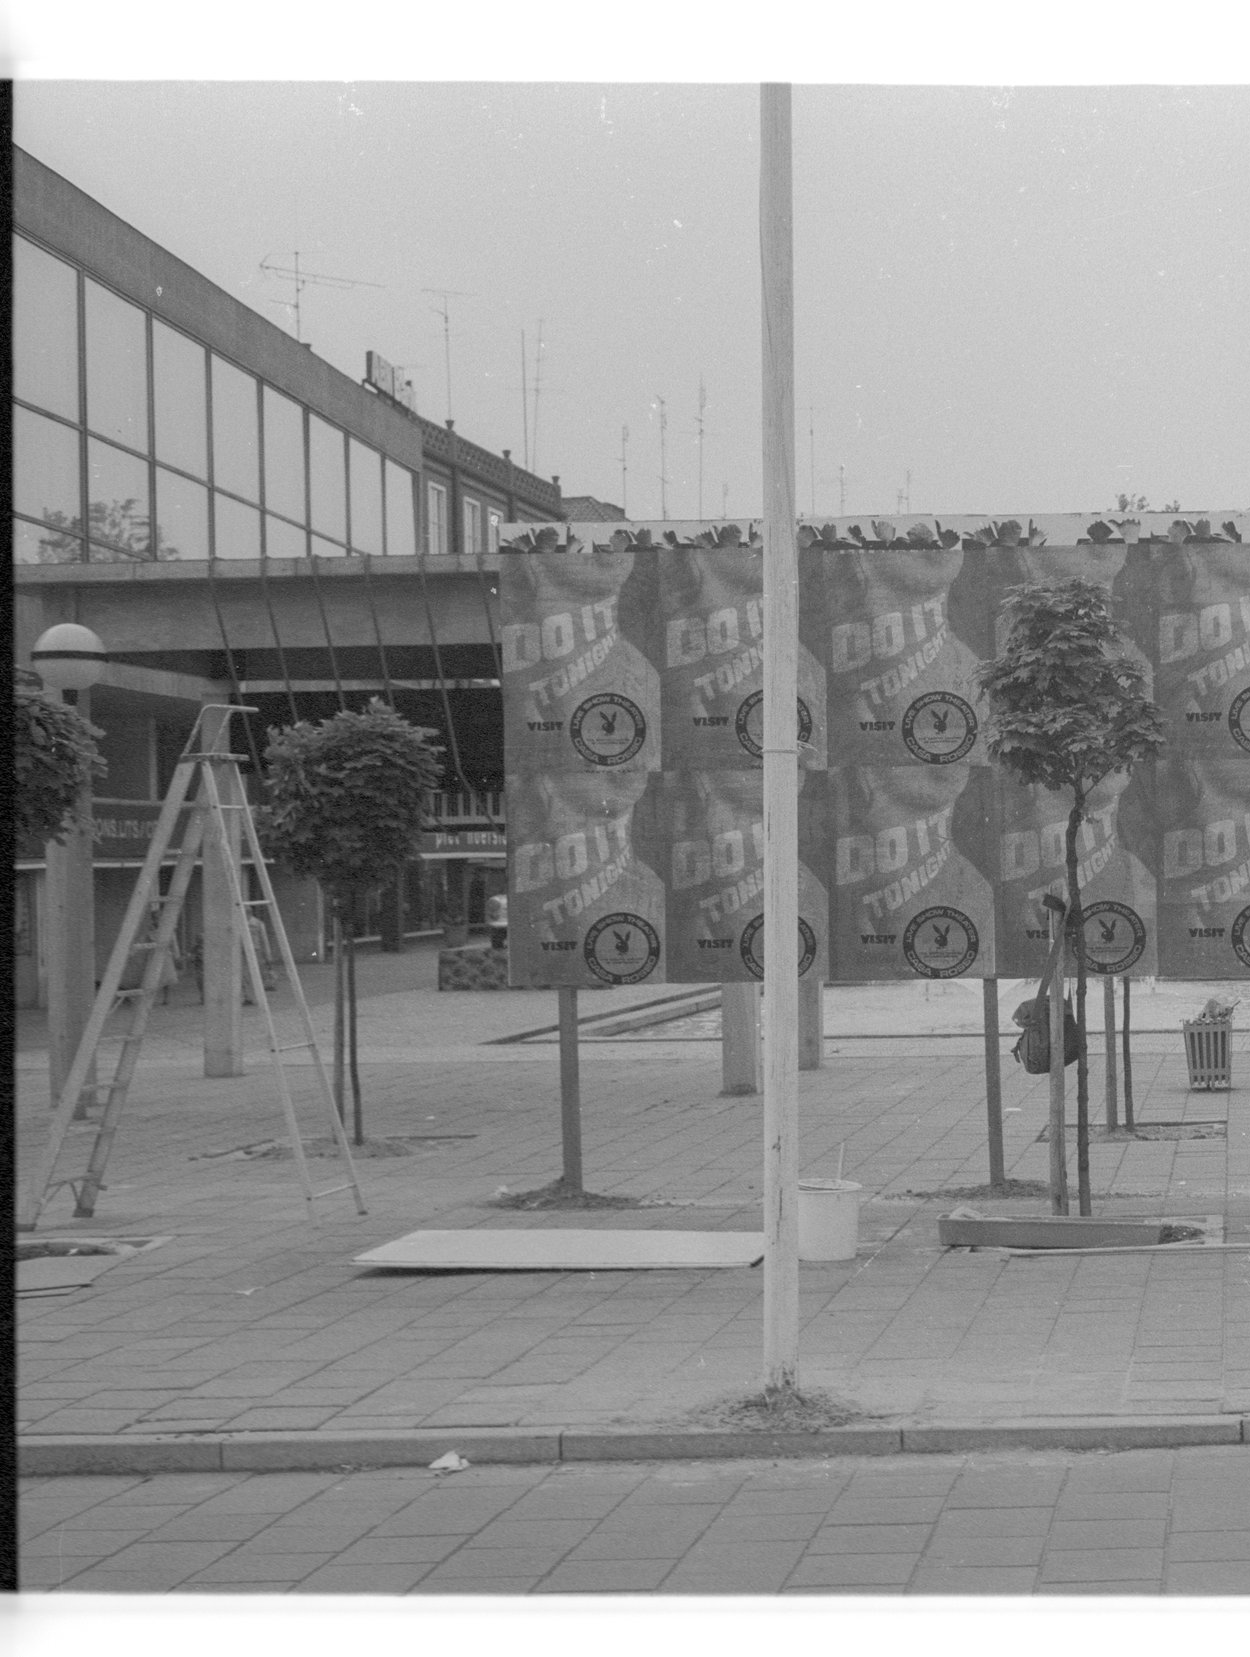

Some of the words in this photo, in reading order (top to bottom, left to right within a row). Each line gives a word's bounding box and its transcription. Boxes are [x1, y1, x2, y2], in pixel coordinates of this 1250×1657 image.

[503, 614, 575, 673] DO
[582, 596, 617, 643] IT
[666, 608, 740, 668] DO
[746, 600, 763, 637] I
[833, 613, 905, 672] DO
[912, 596, 947, 642] IT
[1159, 602, 1232, 662] DO
[694, 639, 763, 700] TONI
[527, 721, 564, 731] VISIT
[692, 716, 730, 727] VISIT
[859, 721, 896, 731] VISIT
[1186, 712, 1222, 722] VISIT
[575, 737, 598, 762] CASA
[607, 736, 642, 763] ROSSO
[906, 736, 930, 761] CASA
[938, 736, 974, 762] ROSSO
[516, 833, 588, 892] DO
[595, 816, 630, 862] IT
[835, 826, 908, 886] DO
[916, 808, 952, 855] IT
[1001, 821, 1068, 882] DO
[1081, 802, 1116, 850] IT
[1163, 820, 1236, 880] DO
[670, 829, 745, 890] DO
[752, 822, 764, 860] I
[541, 941, 578, 951] VISIT
[698, 939, 734, 949] VISIT
[860, 934, 897, 944] VISIT
[1026, 930, 1050, 940] VIS
[1189, 928, 1225, 938] VISIT
[589, 956, 612, 980] CASA
[621, 956, 656, 982] ROSSO
[908, 950, 931, 974] CASA
[940, 950, 974, 976] ROSSO
[1106, 946, 1142, 972] ROSSO
